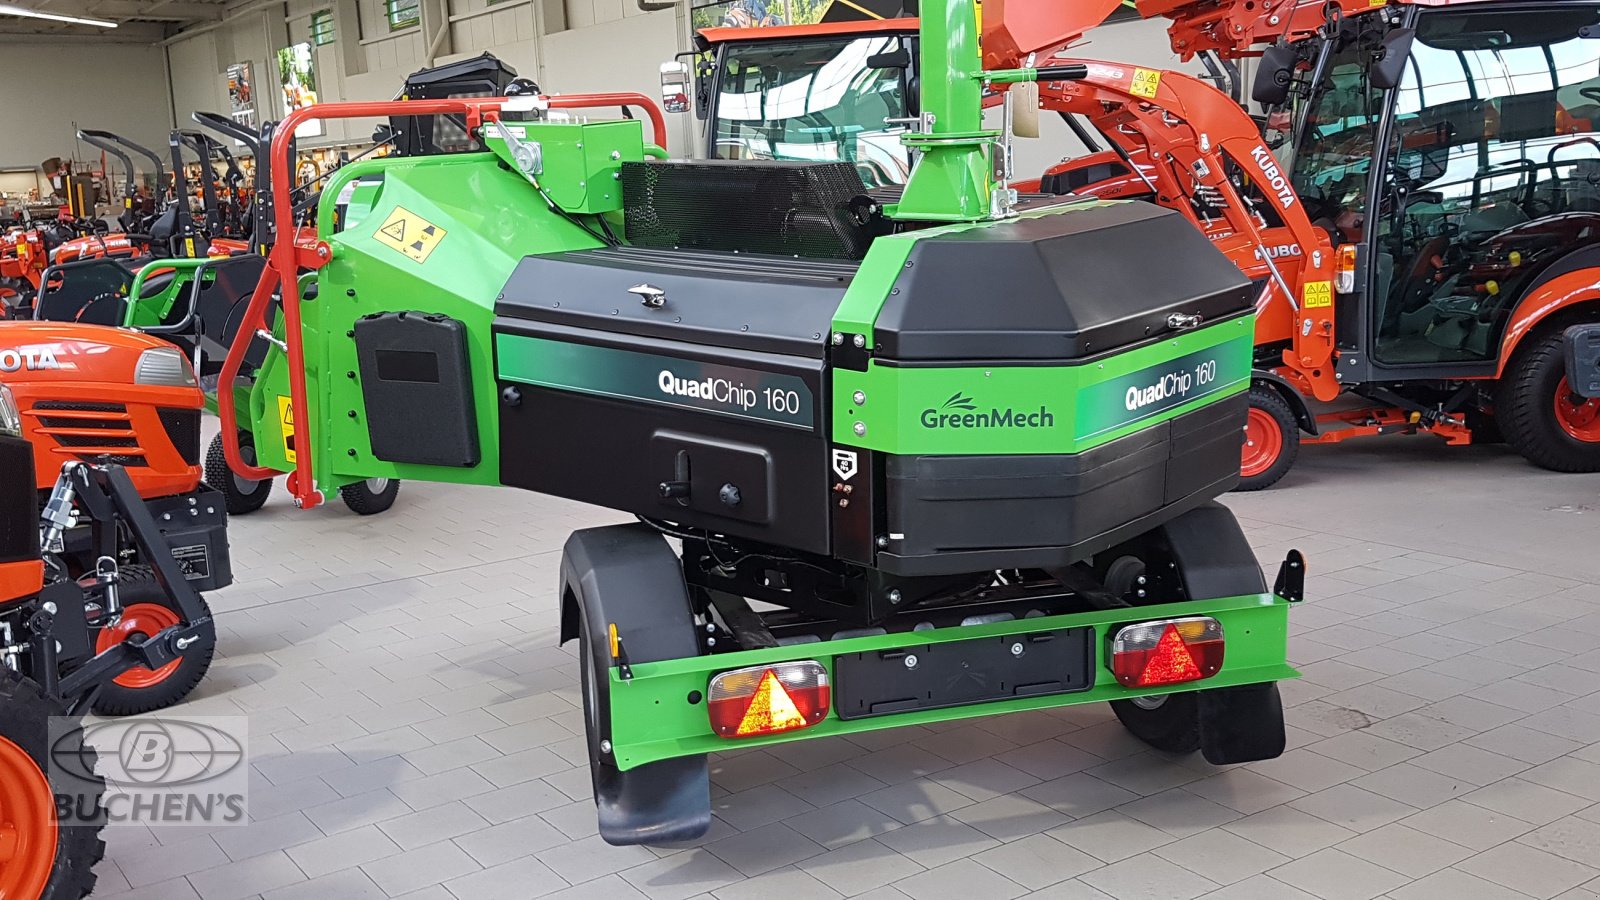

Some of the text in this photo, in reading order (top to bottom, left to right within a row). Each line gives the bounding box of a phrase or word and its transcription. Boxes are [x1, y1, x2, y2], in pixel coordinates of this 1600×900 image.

[1250, 145, 1295, 209] KUBOTA
[658, 370, 800, 414] QuadChip 160
[1125, 360, 1216, 411] QuadChip 160
[920, 406, 1054, 428] GreenMech
